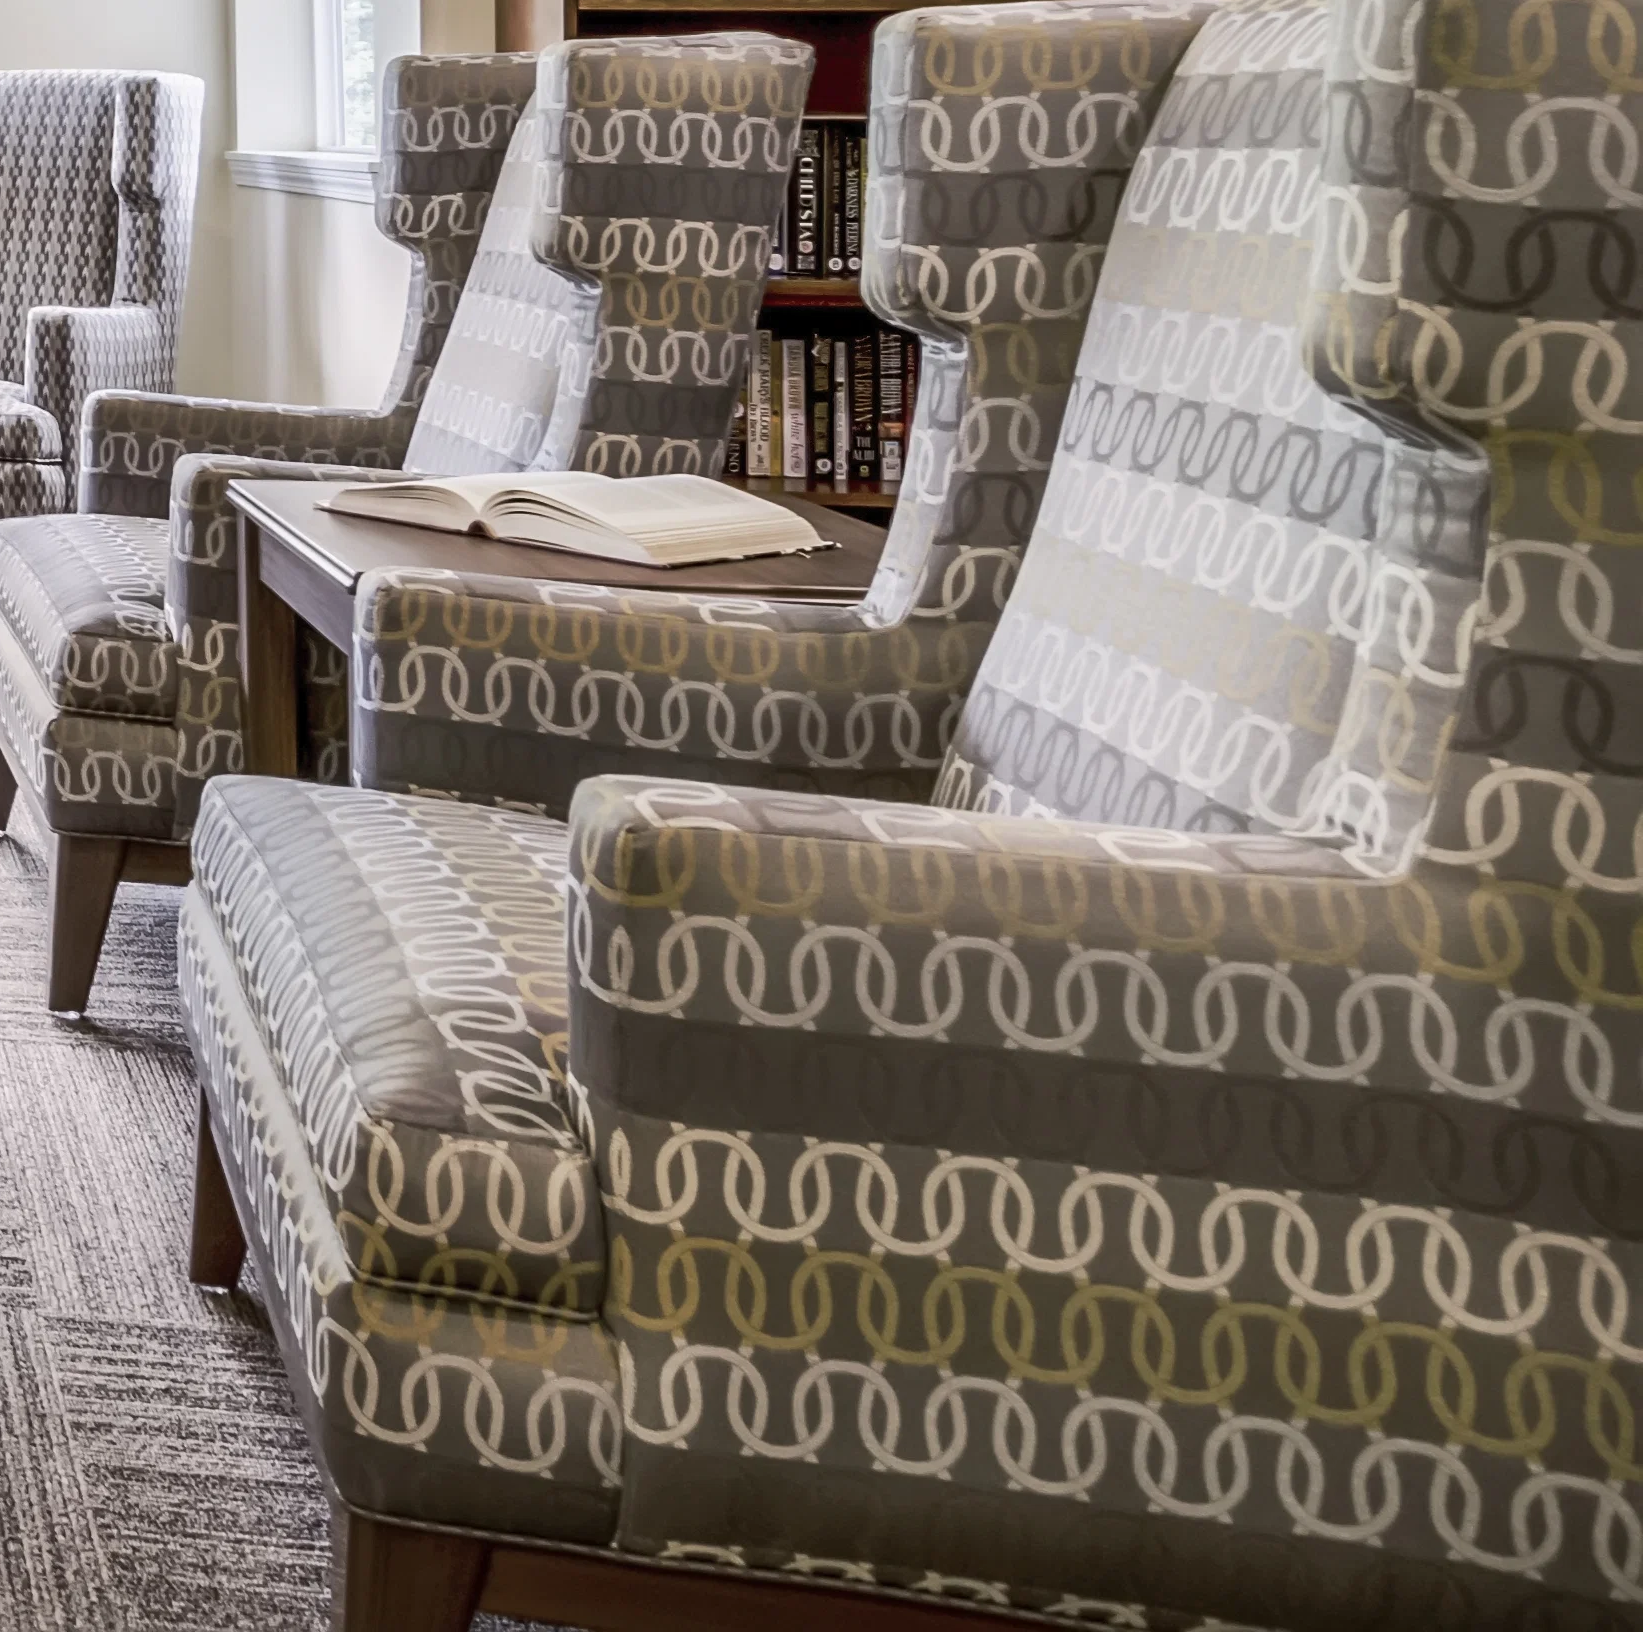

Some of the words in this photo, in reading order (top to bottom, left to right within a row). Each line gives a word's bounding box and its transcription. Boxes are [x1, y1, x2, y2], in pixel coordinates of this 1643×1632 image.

[799, 157, 814, 207] CHILD
[799, 210, 814, 239] STA
[880, 334, 901, 374] SANDRA
[855, 379, 872, 423] BROWN
[881, 378, 901, 416] BROWN
[761, 408, 769, 442] BLOOD
[790, 413, 803, 440] white
